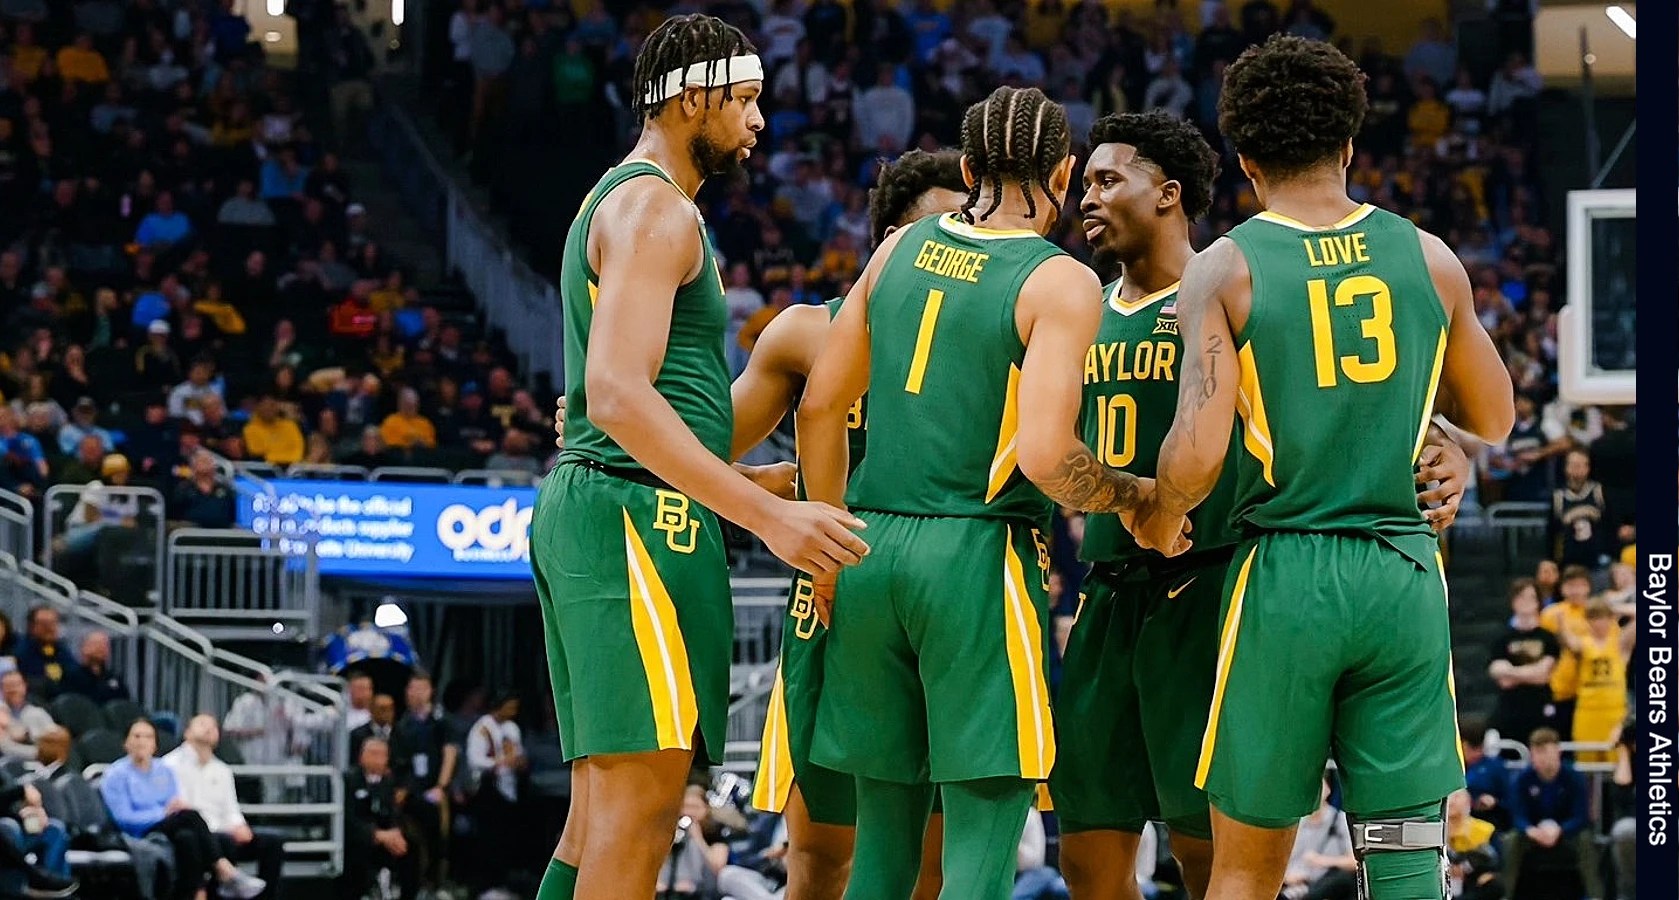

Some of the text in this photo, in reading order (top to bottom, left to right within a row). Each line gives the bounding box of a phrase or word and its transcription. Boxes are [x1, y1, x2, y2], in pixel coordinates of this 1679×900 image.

[914, 239, 989, 283] GEORGE
[1303, 232, 1371, 268] LOVE
[904, 288, 945, 395] 1
[1083, 340, 1176, 385] AYLOR
[1306, 275, 1398, 388] 13
[1096, 393, 1138, 468] 10
[653, 490, 700, 554] BU
